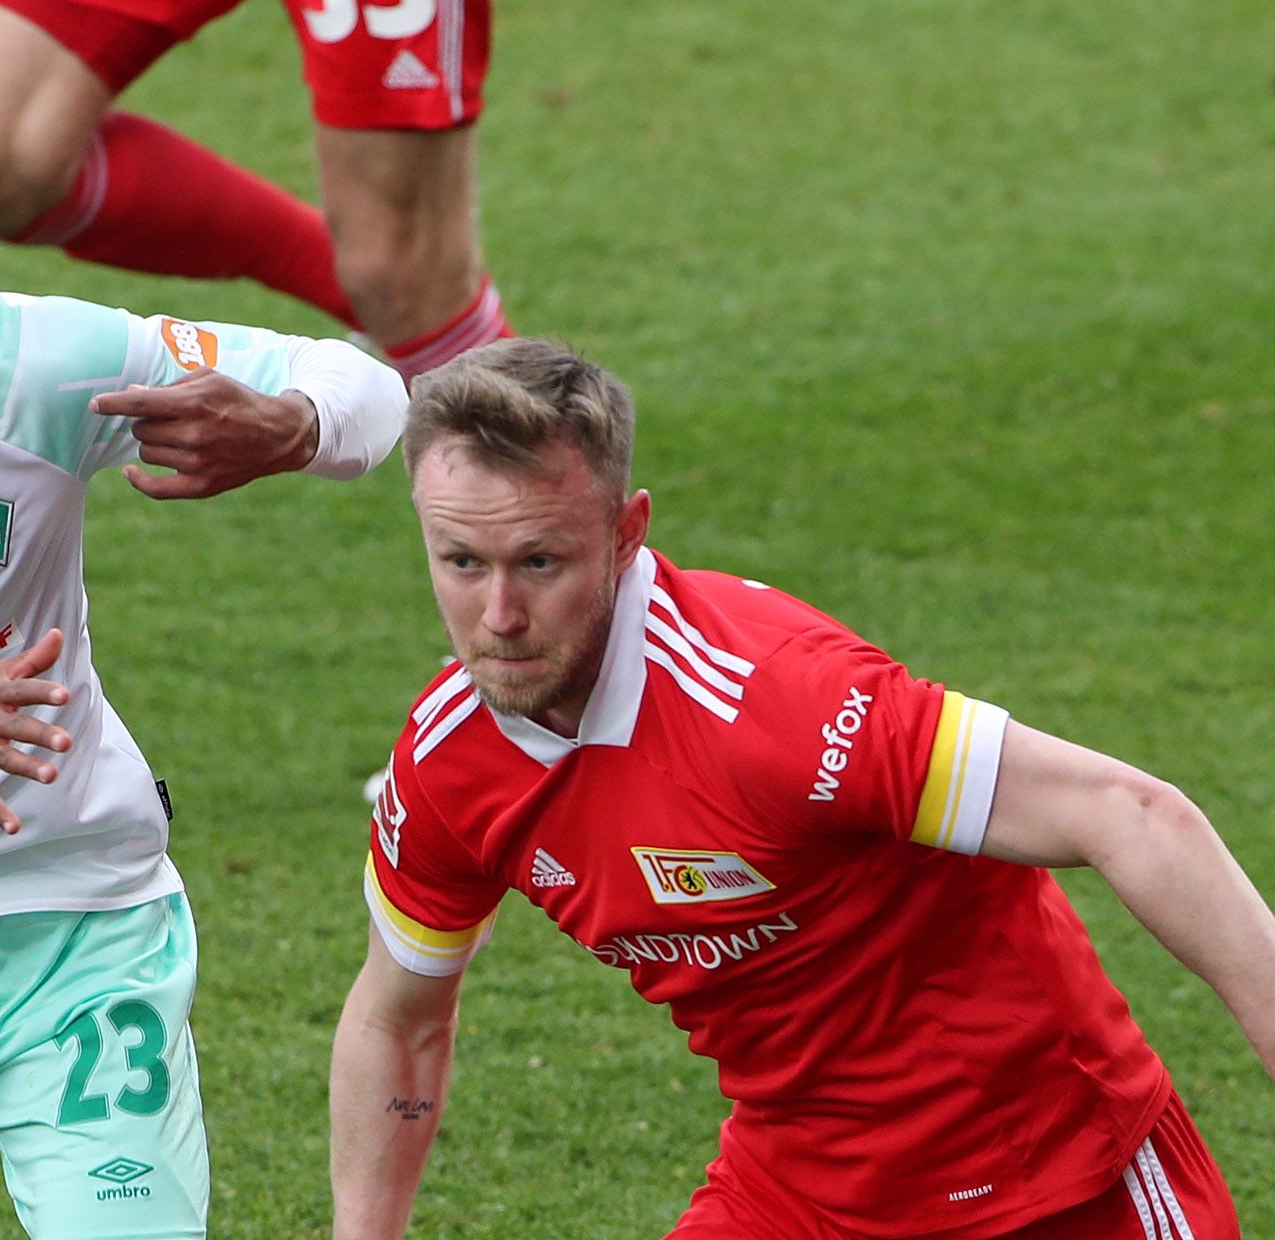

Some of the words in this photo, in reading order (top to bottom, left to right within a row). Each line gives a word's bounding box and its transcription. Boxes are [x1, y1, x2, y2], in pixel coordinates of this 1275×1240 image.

[807, 685, 874, 802] wefox
[531, 871, 577, 888] adidas
[702, 868, 757, 890] UNION
[53, 998, 171, 1129] 23
[96, 1184, 151, 1201] umbro
